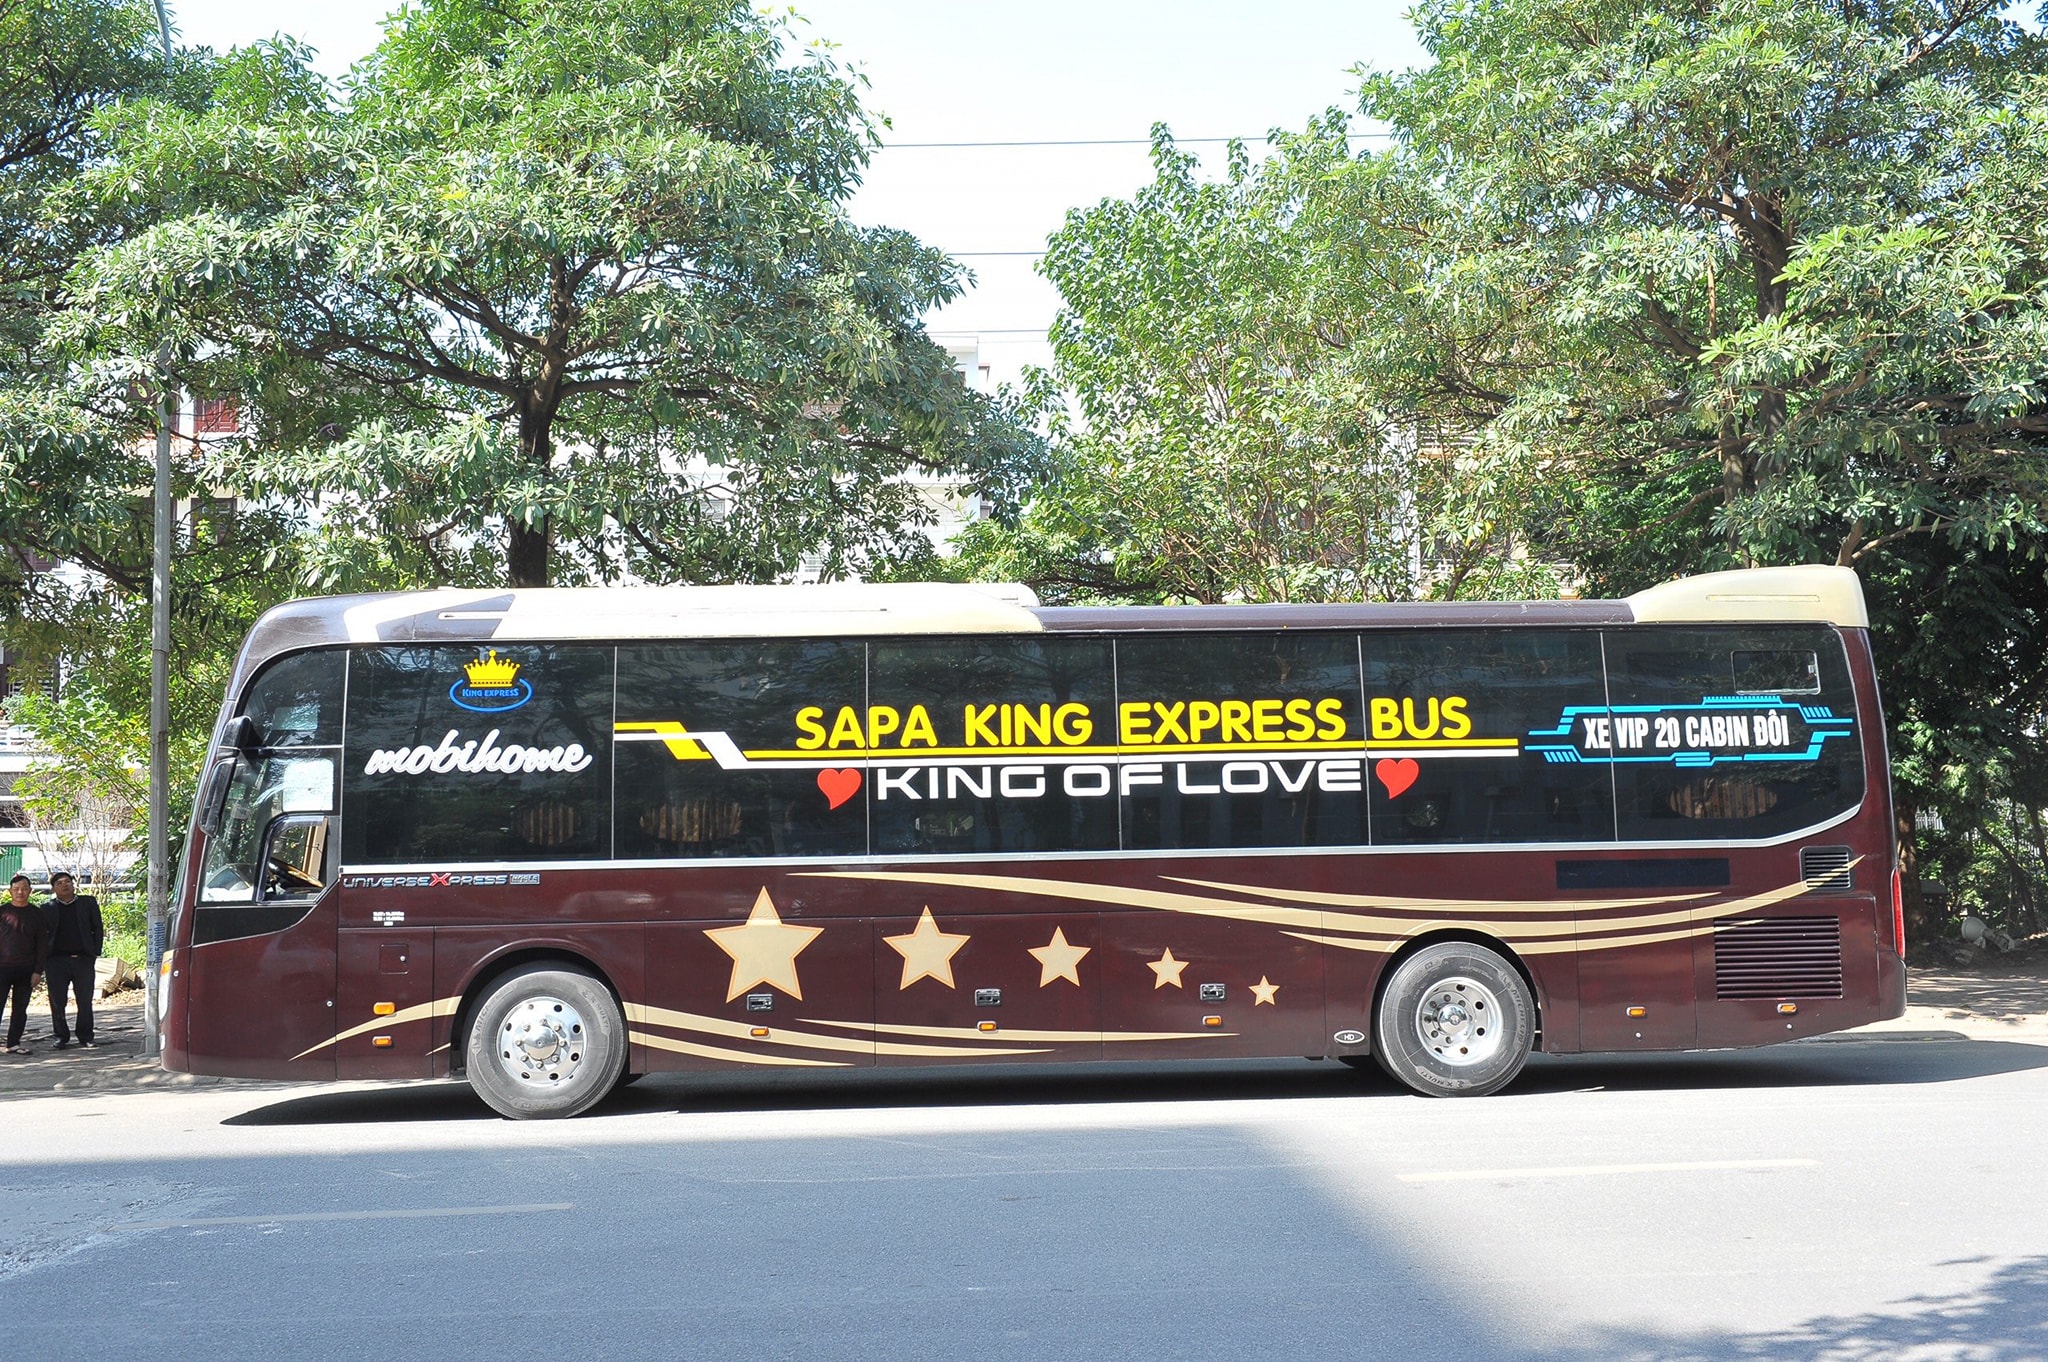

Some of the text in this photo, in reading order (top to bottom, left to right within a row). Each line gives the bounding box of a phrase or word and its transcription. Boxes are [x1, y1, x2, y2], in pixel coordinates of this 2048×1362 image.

[462, 688, 519, 697] KING EXPRESS
[795, 696, 1472, 750] SAPA KING EXPRESS BUS
[1583, 709, 1790, 749] XE VIP 20 CABIN ĐÔI
[364, 728, 593, 775] mobihome
[877, 760, 1362, 800] KING OF LOVE
